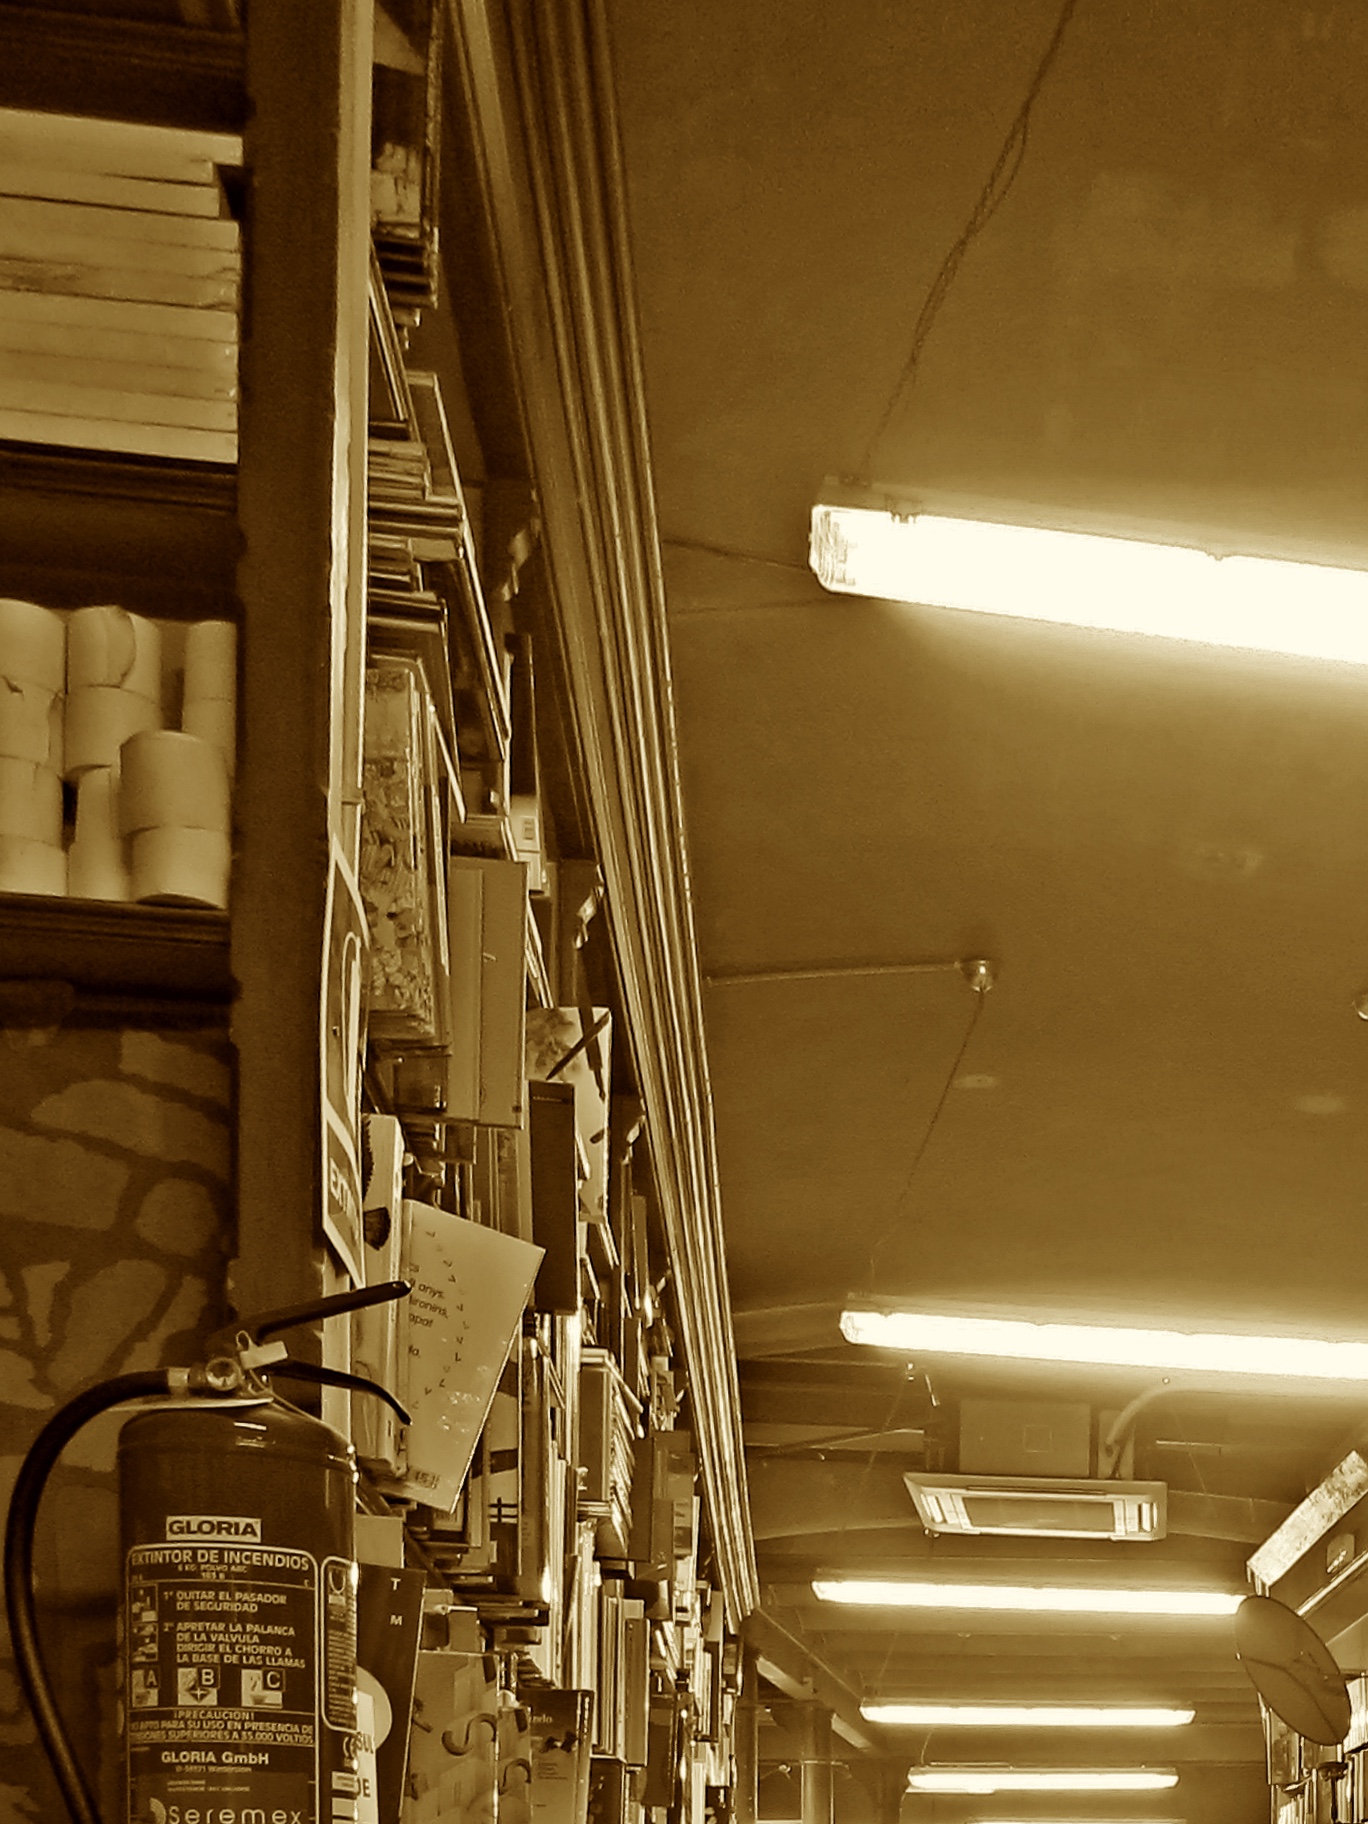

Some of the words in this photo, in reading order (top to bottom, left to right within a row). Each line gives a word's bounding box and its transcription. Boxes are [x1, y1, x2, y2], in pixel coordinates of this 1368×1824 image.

[168, 1519, 258, 1537] GLORIA
[131, 1549, 192, 1566] EXTINTOR
[197, 1549, 219, 1564] DE
[223, 1551, 310, 1572] INCENDIOS
[390, 1578, 401, 1591] T
[176, 1590, 216, 1600] QUITAR
[218, 1591, 232, 1601] EL
[235, 1592, 287, 1605] PASADOR
[176, 1601, 191, 1611] DE
[193, 1601, 259, 1613] SEGURIDAD
[389, 1614, 403, 1626] M
[176, 1622, 226, 1633] APRETAR
[229, 1623, 243, 1632] LA
[246, 1623, 296, 1637] PALANCA
[176, 1632, 191, 1642] DE
[194, 1633, 208, 1643] LA
[176, 1643, 215, 1653] DIRIGIR
[218, 1644, 233, 1653] EL
[235, 1645, 282, 1657] CHORRO
[285, 1647, 293, 1657] A
[176, 1653, 189, 1663] LA
[192, 1653, 220, 1664] BASE
[223, 1654, 239, 1665] DE
[242, 1655, 263, 1666] LAS
[265, 1655, 306, 1668] LLAMAS
[146, 1669, 157, 1686] A
[200, 1668, 215, 1686] B
[266, 1671, 281, 1688] C
[203, 1719, 226, 1730] USO
[227, 1721, 242, 1731] EN
[161, 1751, 217, 1764] GLORIA
[221, 1751, 269, 1766] GmbH
